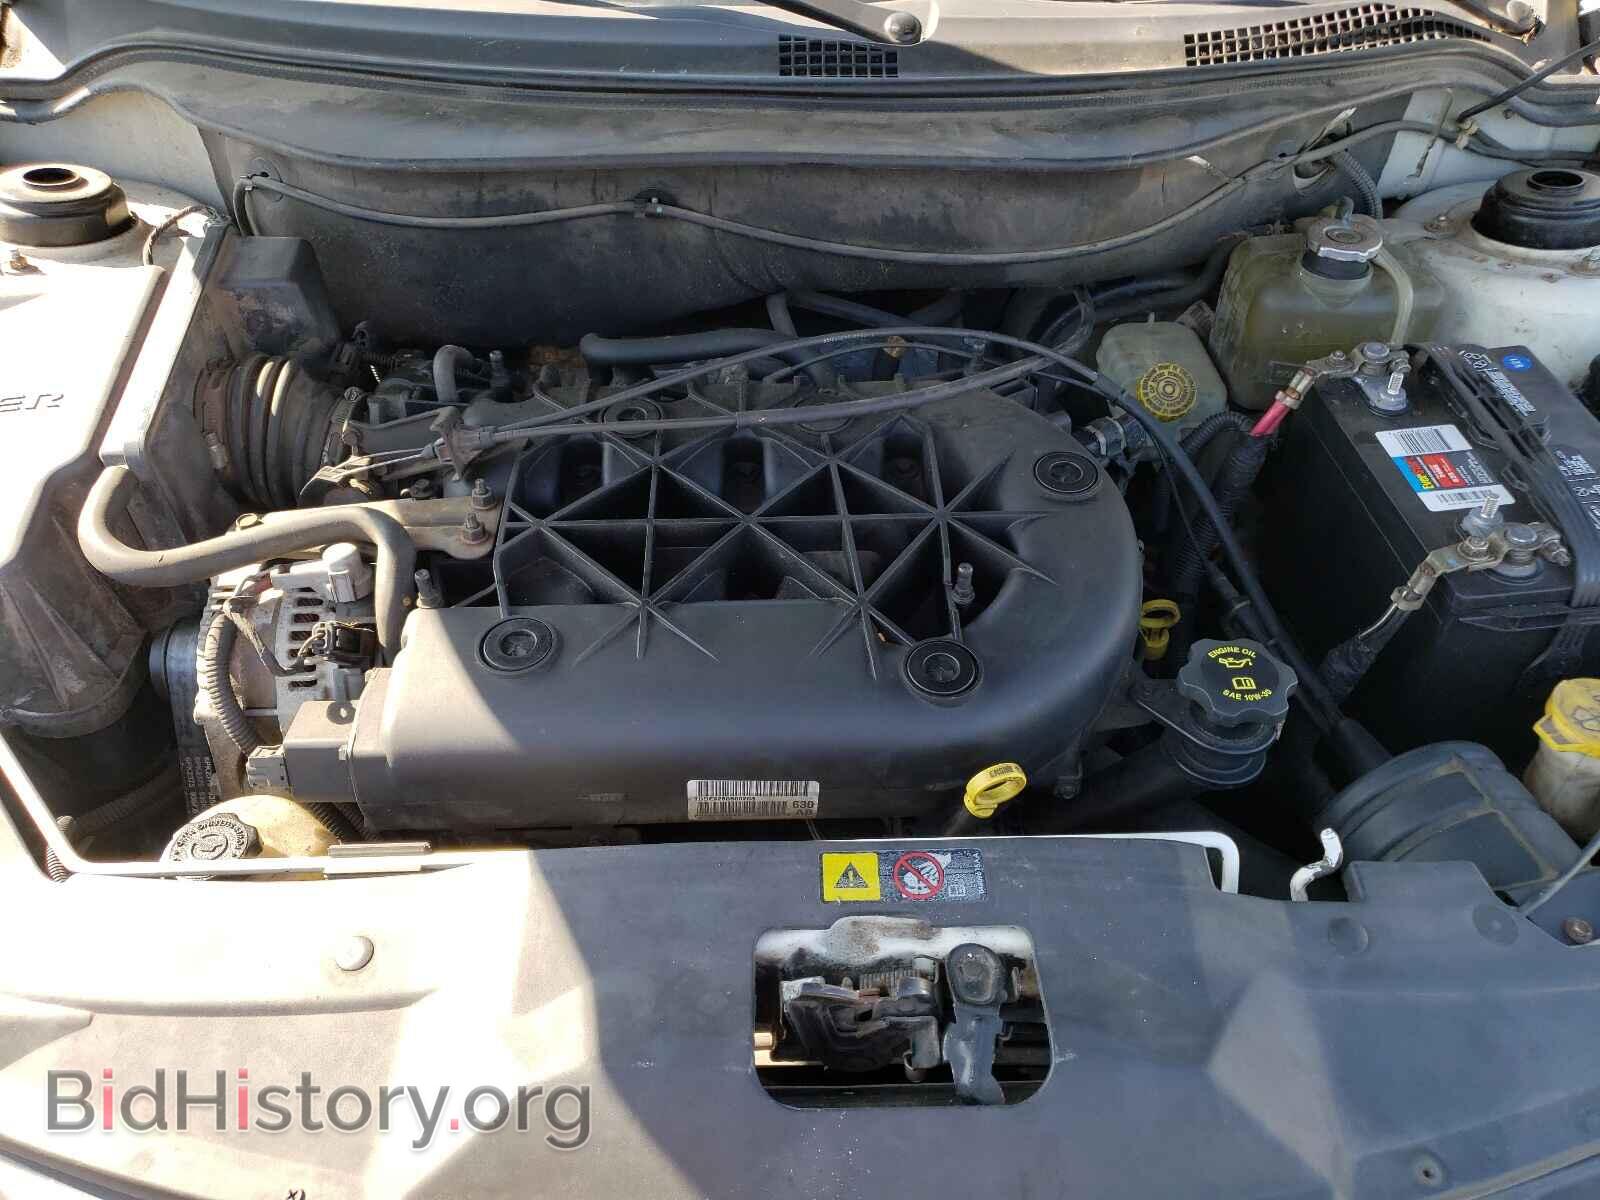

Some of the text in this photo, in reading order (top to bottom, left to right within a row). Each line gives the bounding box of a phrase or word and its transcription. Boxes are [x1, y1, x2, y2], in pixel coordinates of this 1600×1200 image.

[1208, 646, 1256, 658] ENGINE OIL
[1222, 689, 1242, 700] SAE
[792, 801, 814, 809] 630
